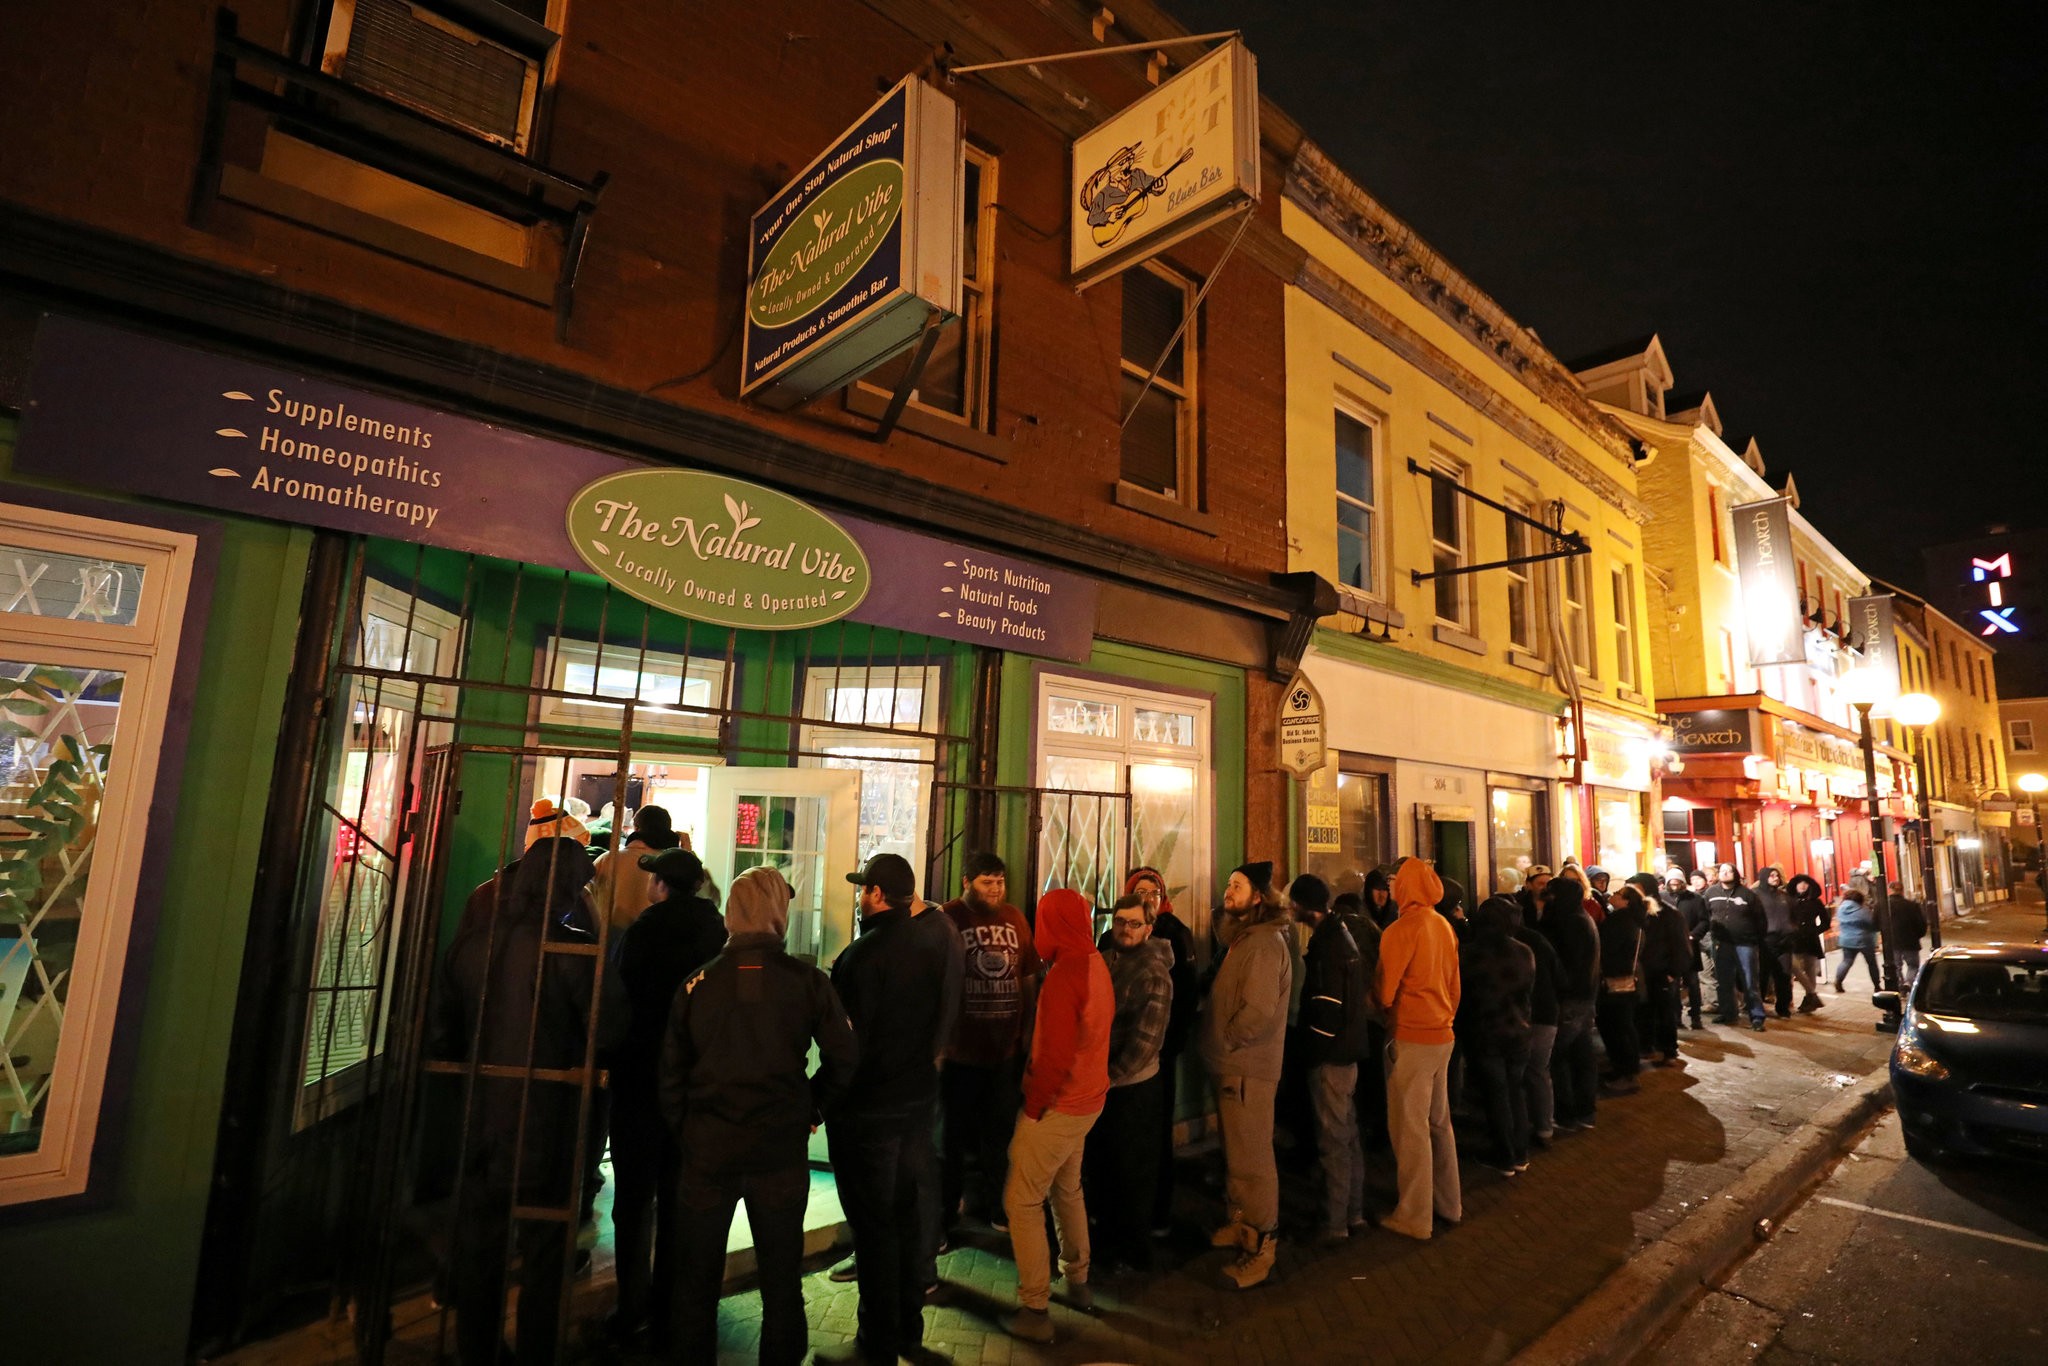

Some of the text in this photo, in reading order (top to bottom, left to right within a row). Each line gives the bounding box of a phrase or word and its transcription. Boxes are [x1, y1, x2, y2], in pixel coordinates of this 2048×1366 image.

[785, 193, 803, 215] One
[804, 170, 825, 195] Stop
[827, 140, 863, 175] Natural
[1201, 166, 1223, 186] Bar
[760, 184, 893, 298] The Natural Vibe
[768, 224, 875, 315] Locally Owned & Operated
[754, 276, 888, 372] Natural Products & Smoothie Bar
[266, 388, 433, 449] Supplements
[260, 426, 442, 488] Homeopathics
[251, 466, 439, 529] Aromatherapy
[594, 500, 857, 585] The Natural Vibe
[615, 551, 827, 614] Locally Owned & Operated
[960, 583, 1038, 616] Natural Foods
[962, 558, 1051, 595] Sports Nutrition
[1972, 552, 2021, 637] MIX
[957, 608, 1046, 642] Beauty Products
[1316, 808, 1339, 827] LEASE
